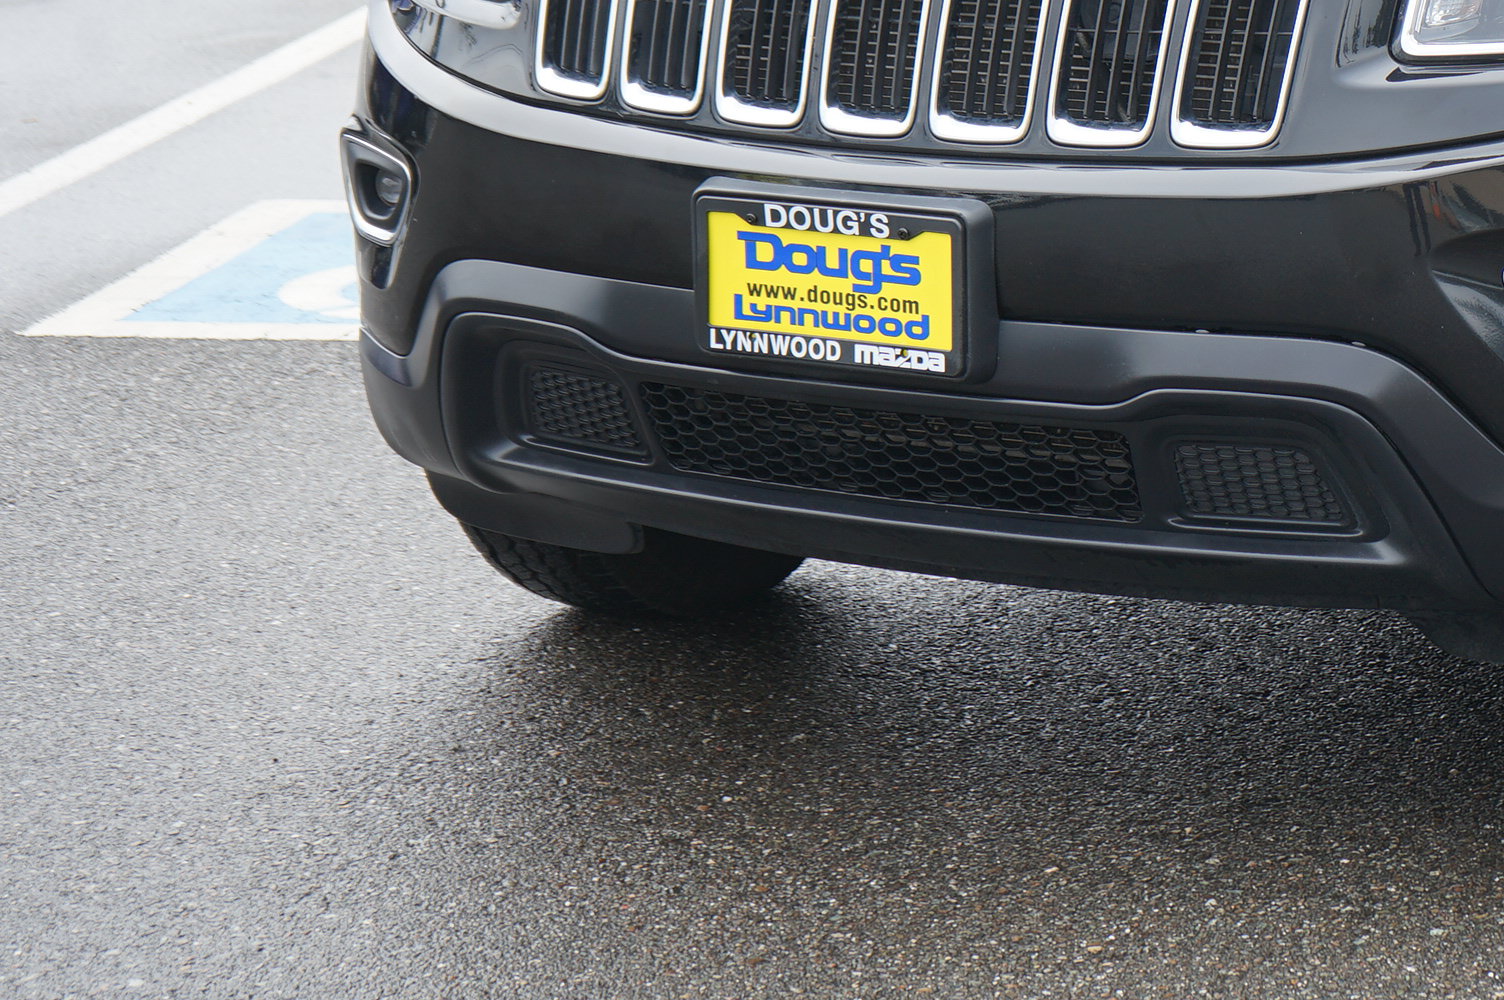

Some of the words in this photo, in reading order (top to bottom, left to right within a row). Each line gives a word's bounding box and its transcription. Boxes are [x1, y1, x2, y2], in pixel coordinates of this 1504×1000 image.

[763, 203, 890, 239] DOUG'S
[737, 230, 922, 295] Doug's
[747, 282, 920, 315] www.dougs.com
[734, 294, 930, 340] Lynnwood
[709, 328, 841, 361] LYNNWOOD
